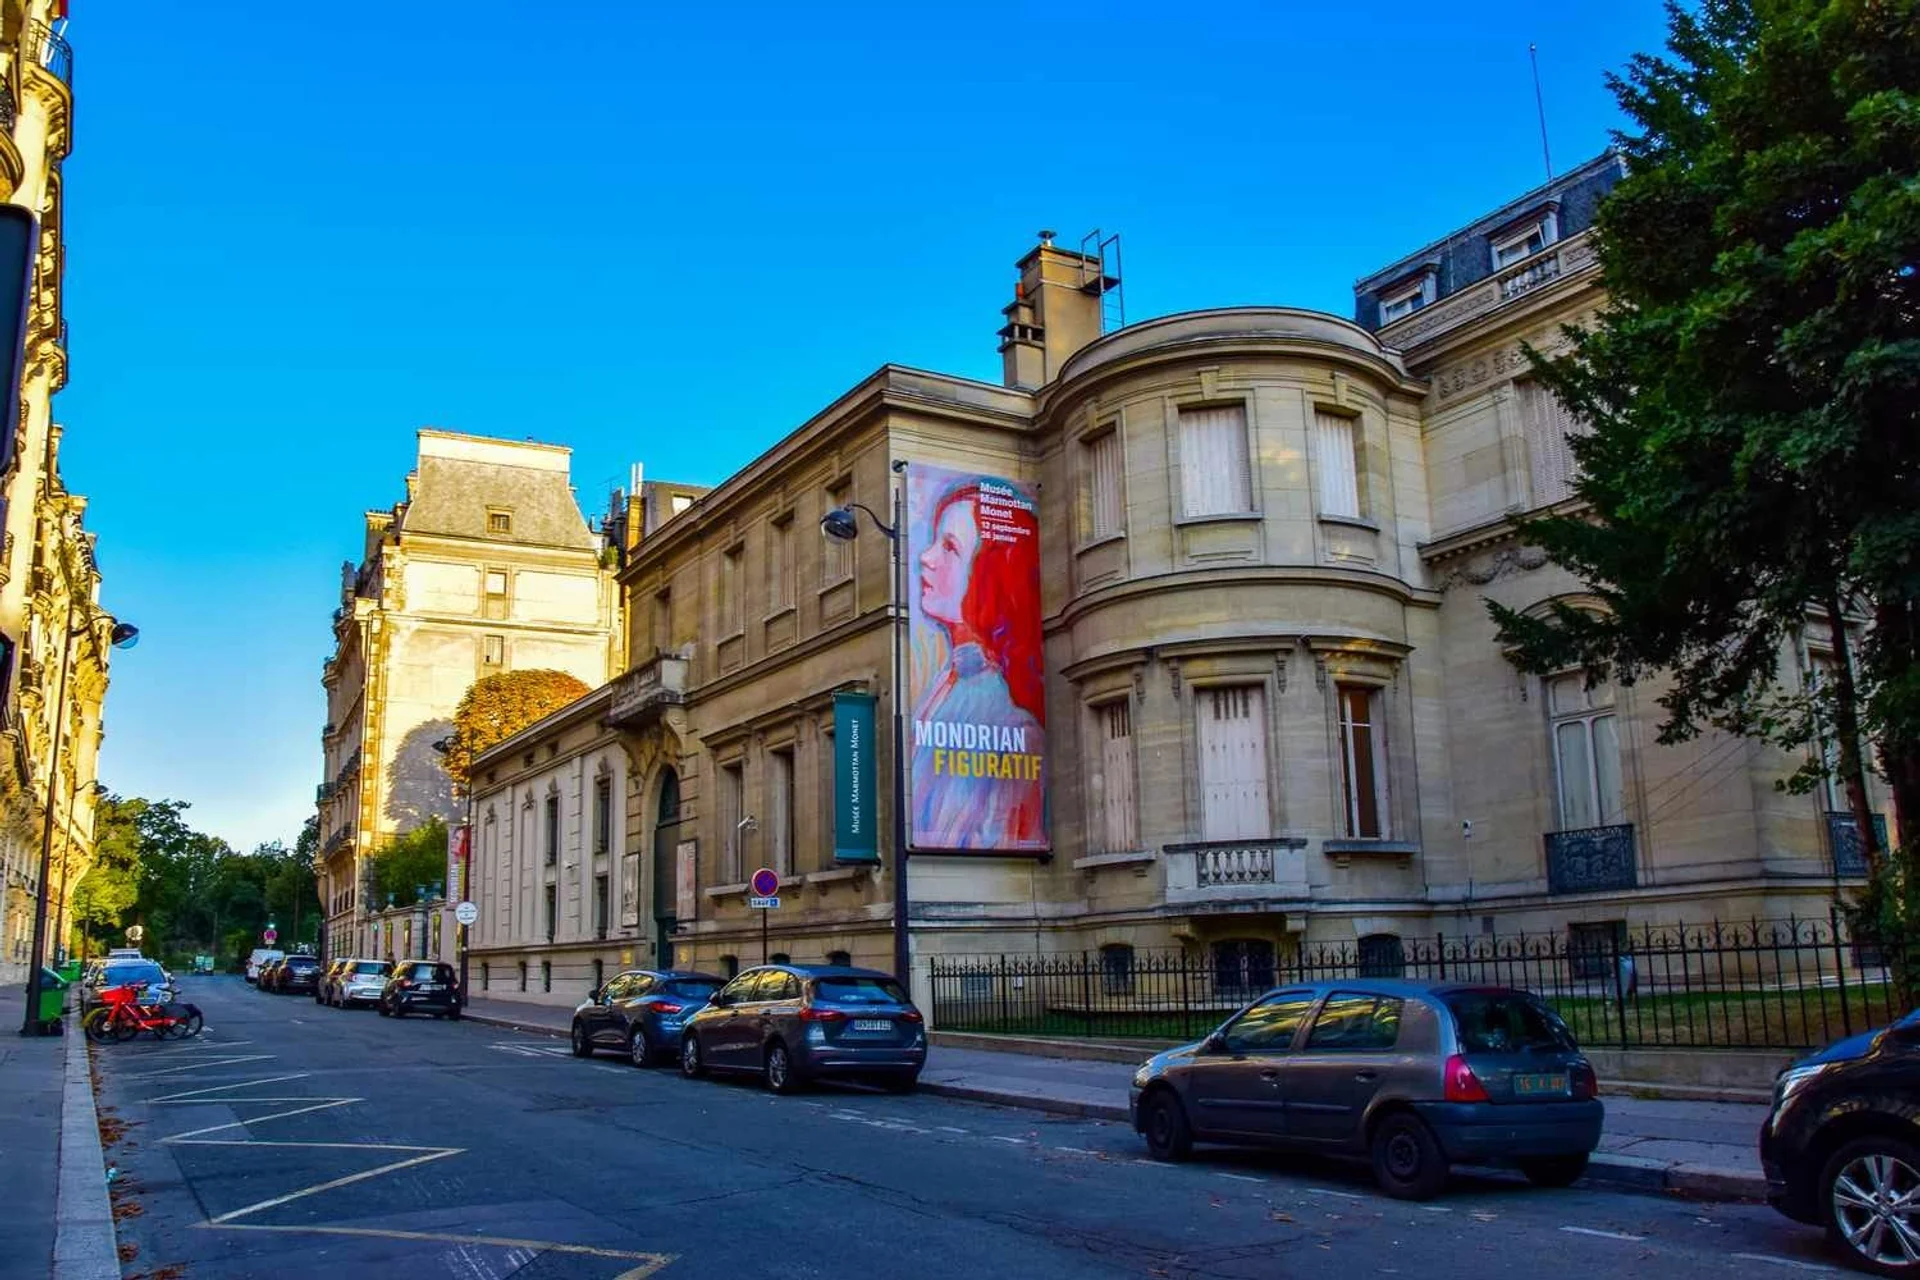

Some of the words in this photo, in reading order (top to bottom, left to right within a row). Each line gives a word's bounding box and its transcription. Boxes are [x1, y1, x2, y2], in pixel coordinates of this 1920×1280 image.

[980, 482, 1013, 496] Musée
[980, 493, 1032, 511] Marmottan
[980, 505, 1013, 519] Monet
[981, 521, 990, 530] 12
[992, 523, 1031, 536] septembre
[992, 531, 1017, 543] janvier
[915, 720, 1026, 752] MONDRIAN
[934, 748, 1043, 780] FIGURATIF
